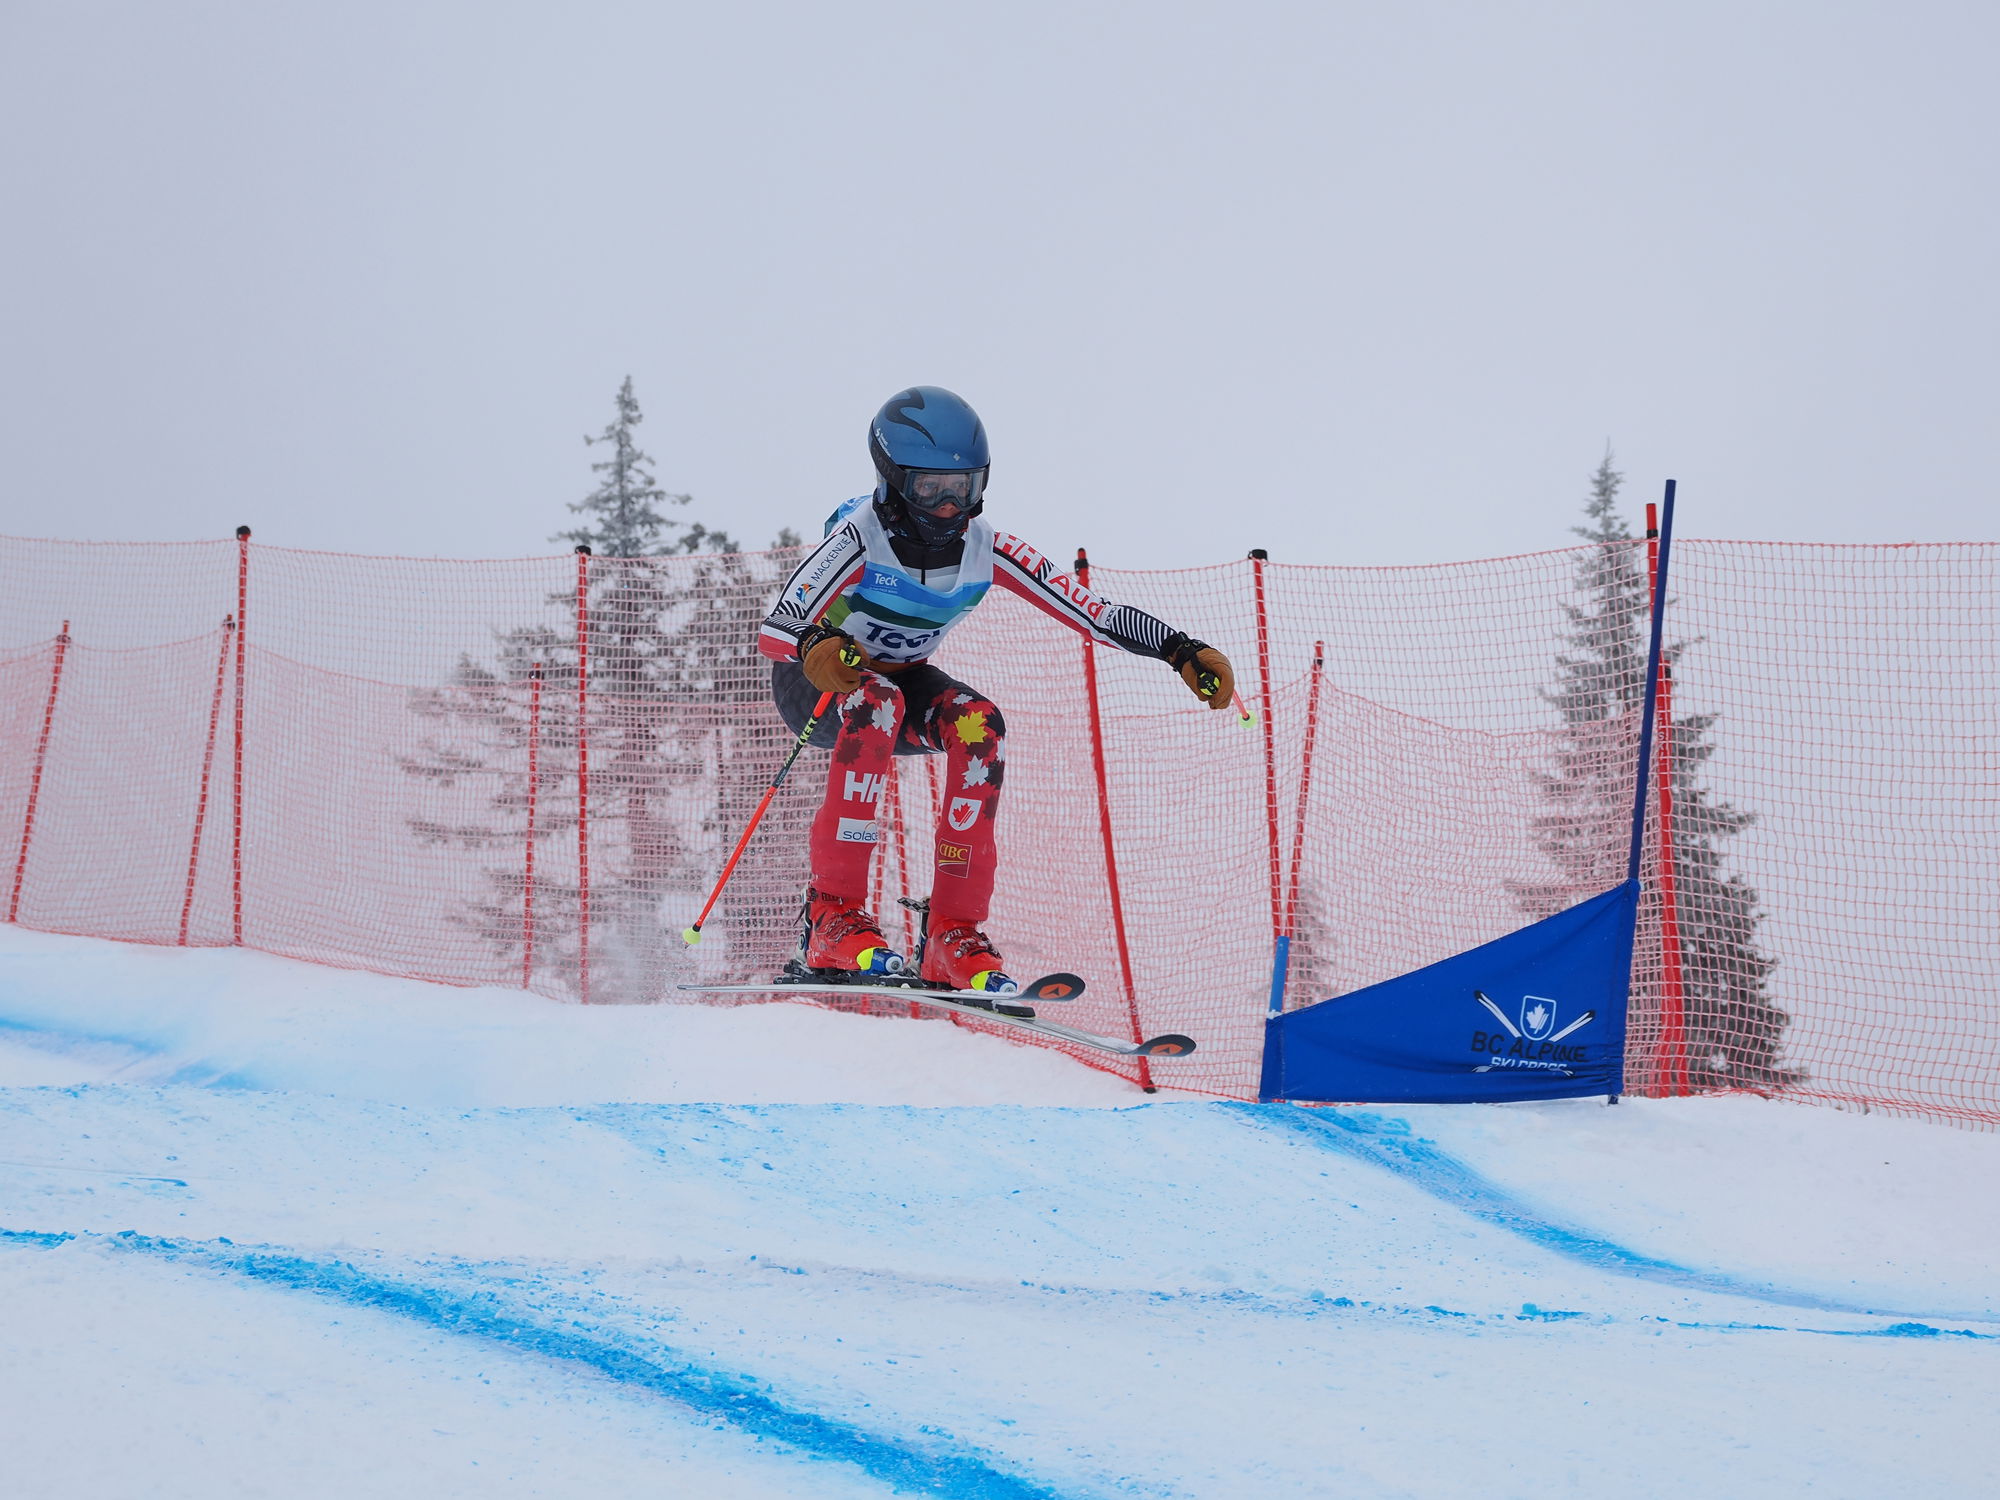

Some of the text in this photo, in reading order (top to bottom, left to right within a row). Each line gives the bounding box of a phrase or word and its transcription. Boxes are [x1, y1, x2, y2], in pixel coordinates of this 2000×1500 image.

[811, 538, 852, 582] MACKENZIE
[875, 573, 899, 587] Teck
[1048, 574, 1105, 620] Aud
[940, 843, 968, 861] CIBC
[1472, 1031, 1590, 1063] BC ALPINE
